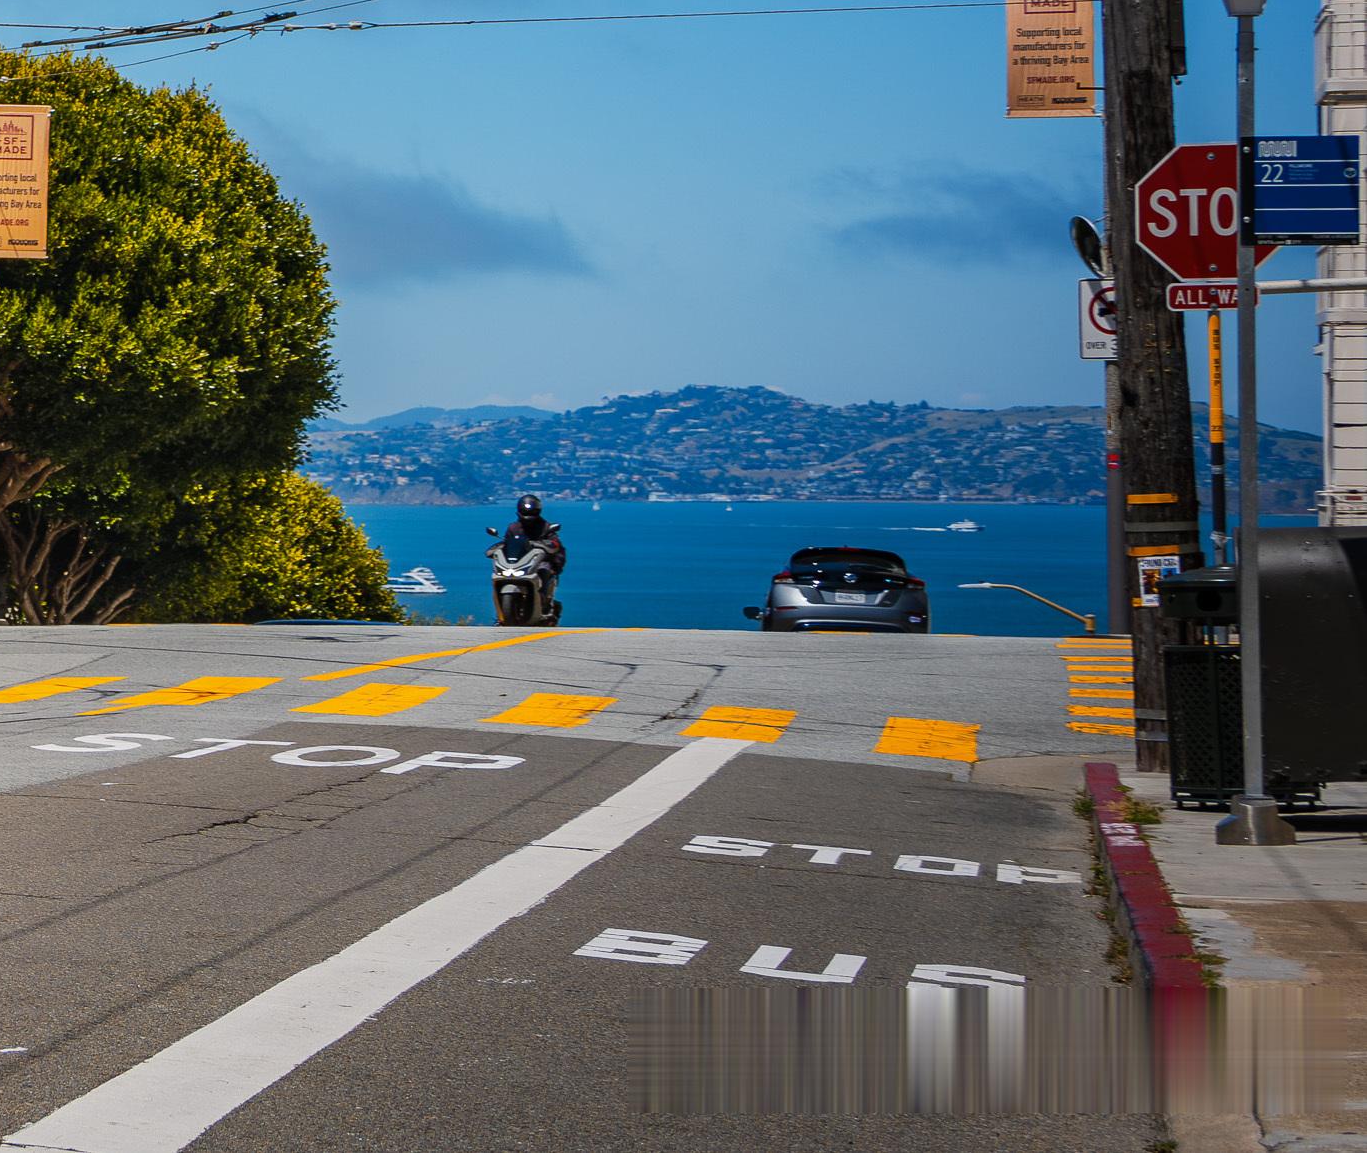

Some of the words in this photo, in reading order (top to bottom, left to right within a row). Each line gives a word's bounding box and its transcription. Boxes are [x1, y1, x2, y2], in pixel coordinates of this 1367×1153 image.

[1016, 27, 1060, 39] Supporting
[1062, 27, 1082, 36] local
[1013, 42, 1072, 51] manufacturers
[1074, 41, 1086, 50] for
[1020, 55, 1051, 67] thriving
[1053, 55, 1067, 67] Bay
[1070, 55, 1090, 65] Area
[1027, 75, 1075, 84] SFMADE.ORG
[3, 137, 18, 145] SF
[20, 173, 37, 182] local
[1260, 163, 1284, 183] 22
[30, 187, 40, 196] for
[10, 200, 24, 211] Bay
[25, 200, 42, 209] Area
[1147, 187, 1239, 238] STO
[1175, 289, 1208, 305] ALL
[1217, 289, 1239, 304] WA
[1086, 341, 1107, 350] OVER
[29, 732, 527, 776] STOP
[681, 834, 1084, 885] STOP
